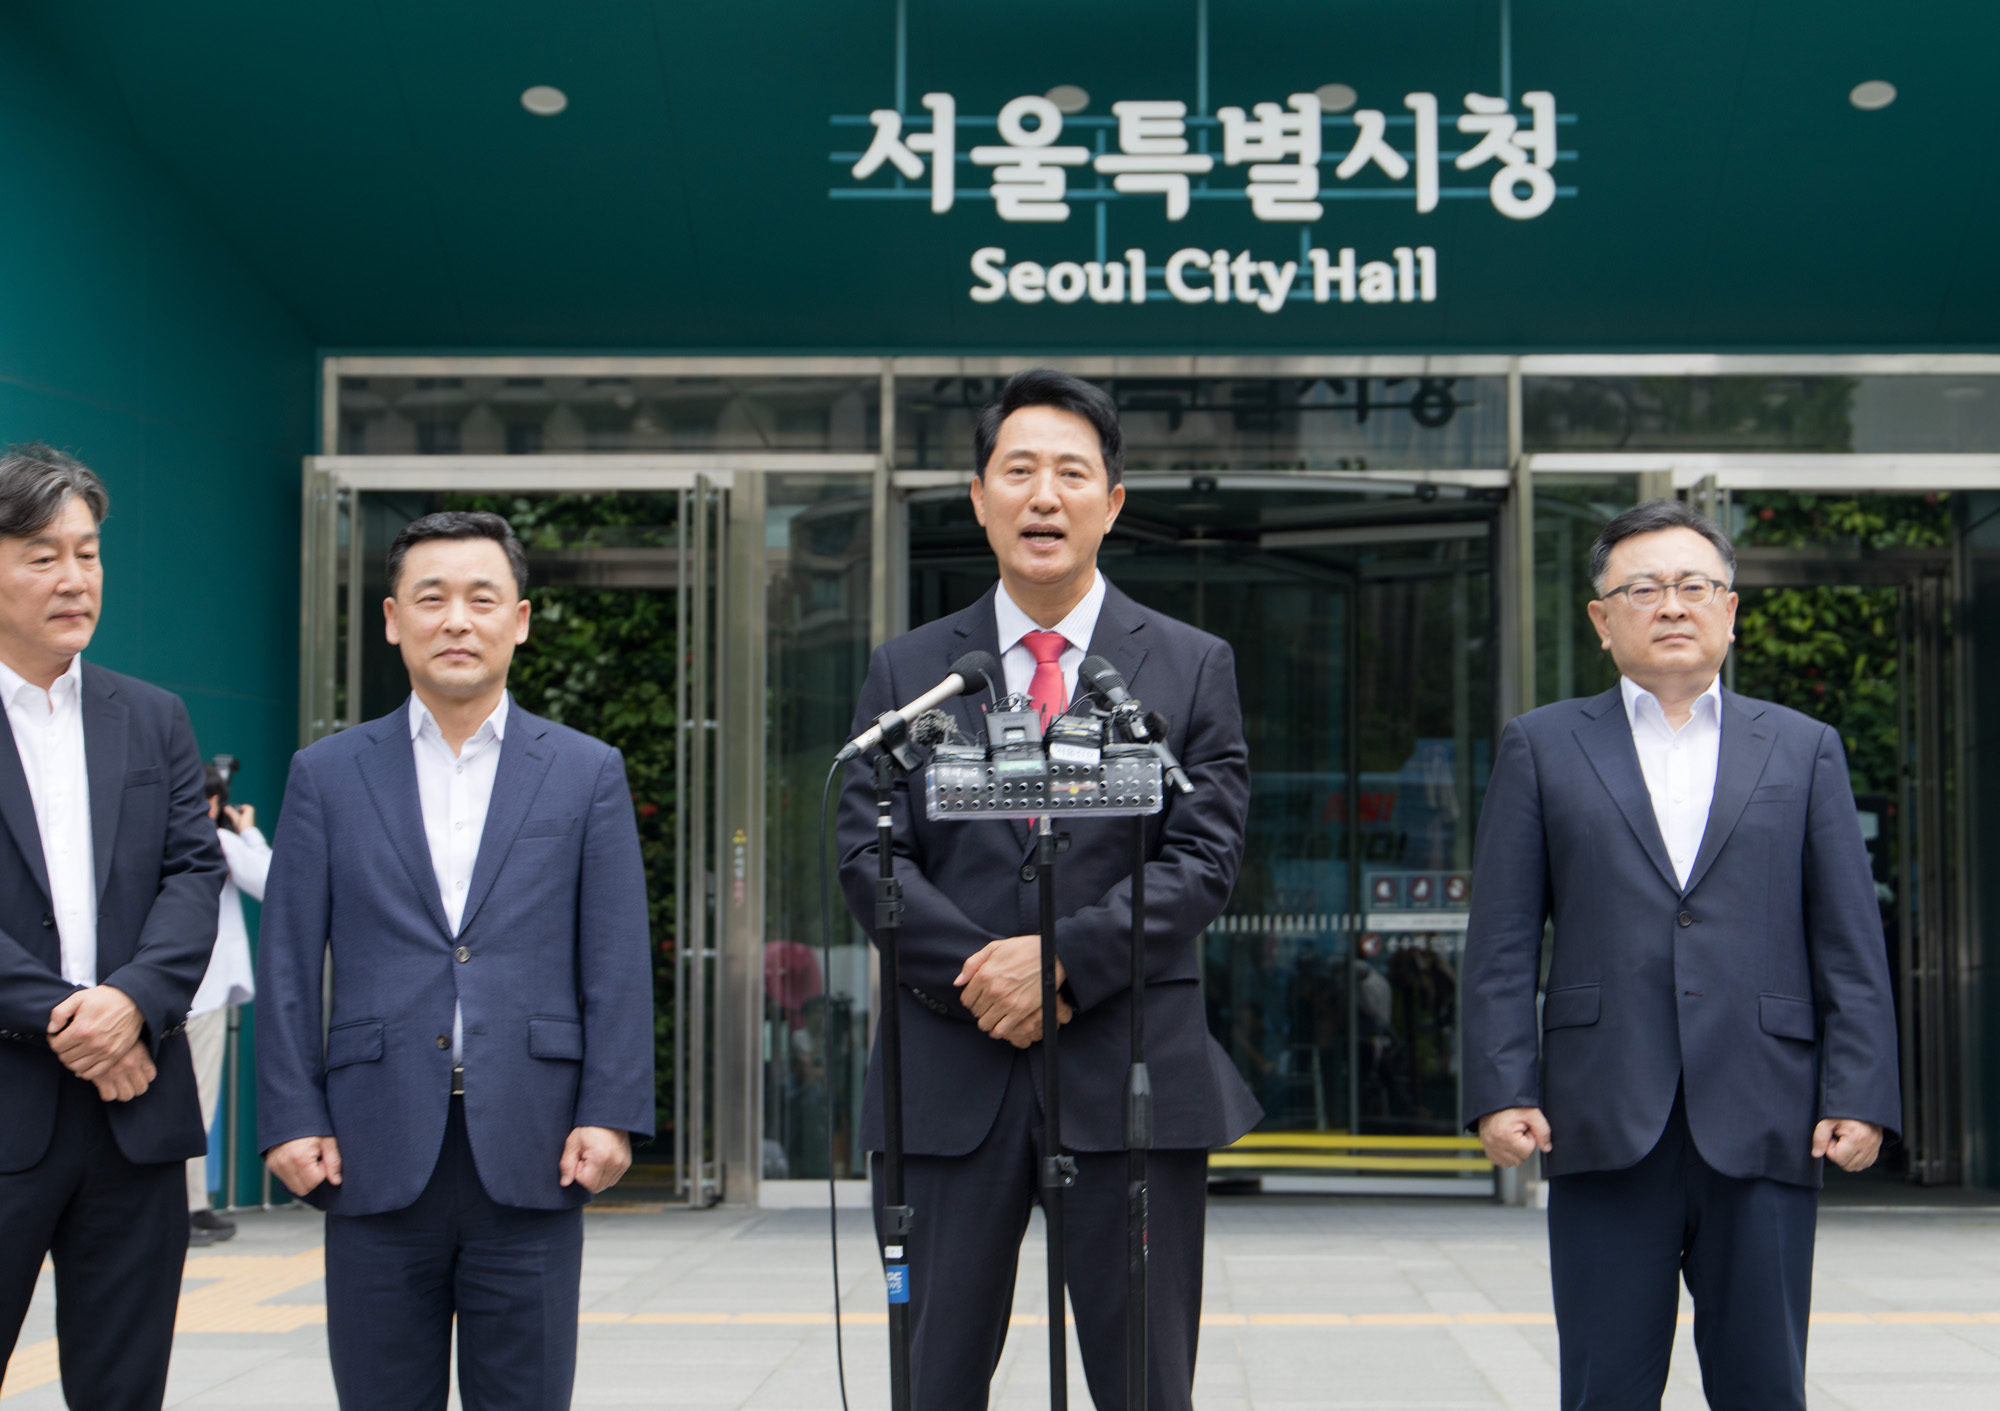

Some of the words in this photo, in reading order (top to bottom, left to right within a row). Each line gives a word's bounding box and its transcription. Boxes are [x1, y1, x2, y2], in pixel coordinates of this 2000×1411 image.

[852, 91, 1557, 222] 서울특별시청
[970, 247, 1146, 304] Seoul
[1165, 248, 1298, 313] City
[1307, 247, 1437, 303] Hall
